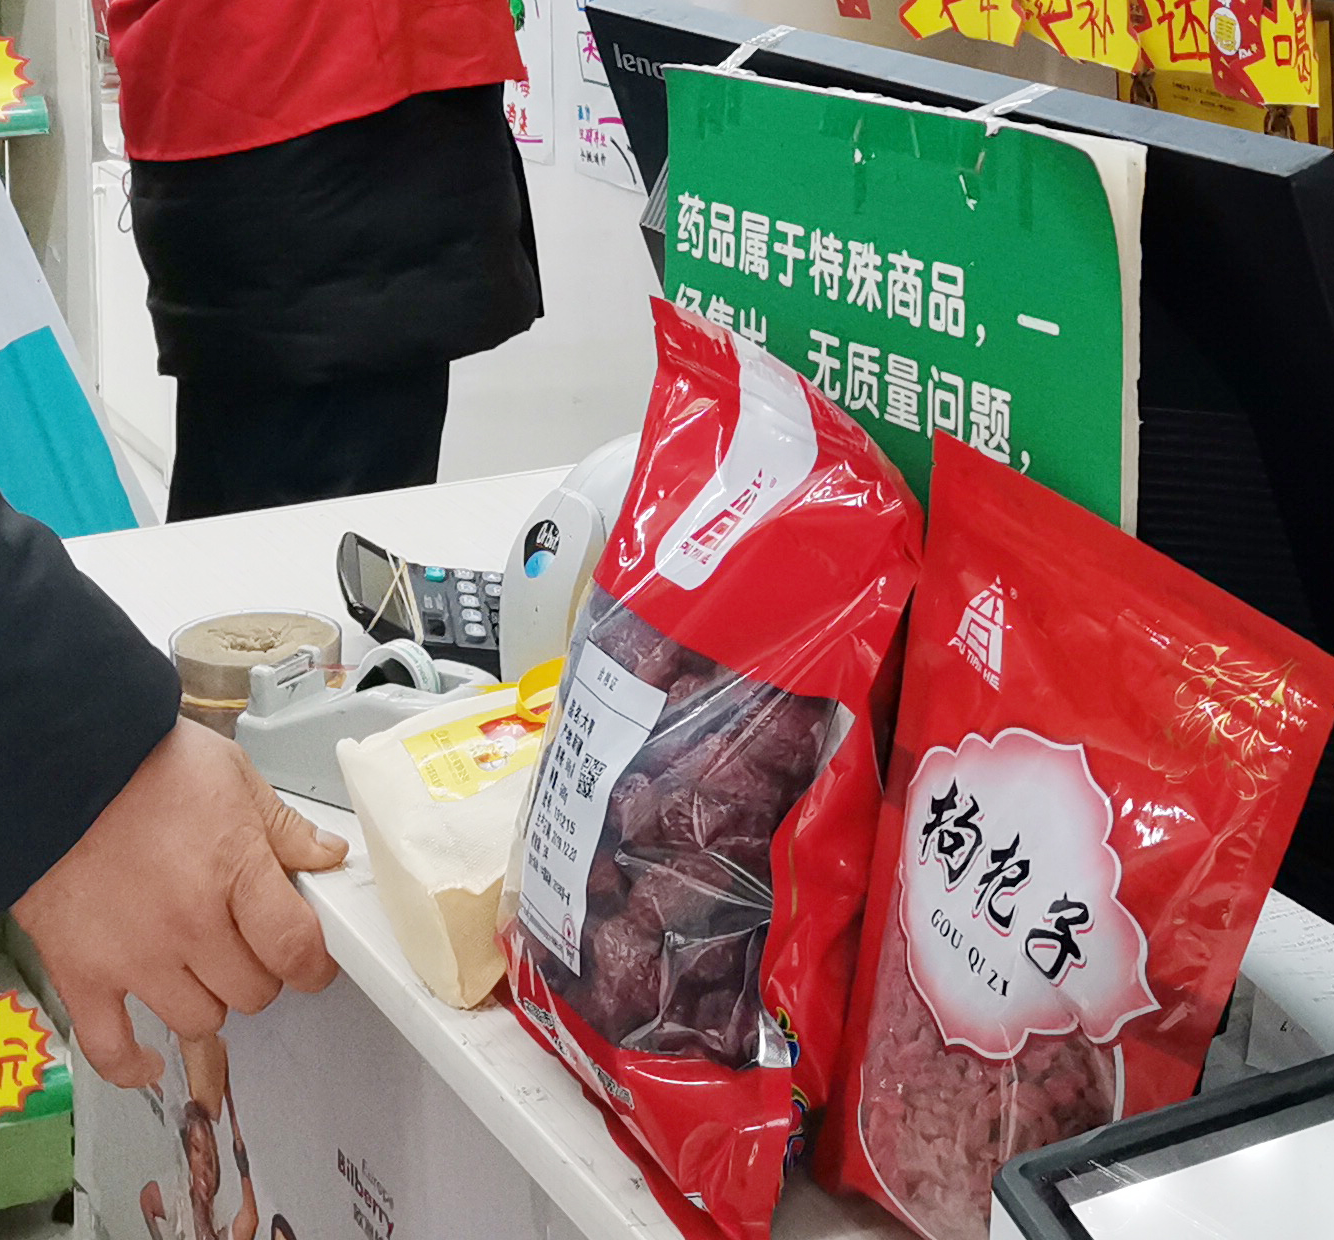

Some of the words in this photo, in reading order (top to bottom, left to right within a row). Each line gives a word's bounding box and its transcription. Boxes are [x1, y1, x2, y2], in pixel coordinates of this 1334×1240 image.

[676, 190, 1062, 348] 药品属于特殊商品，一
[921, 776, 1091, 981] 枸杞子
[930, 908, 964, 950] GOU
[967, 946, 987, 976] QI
[986, 968, 1011, 998] ZI
